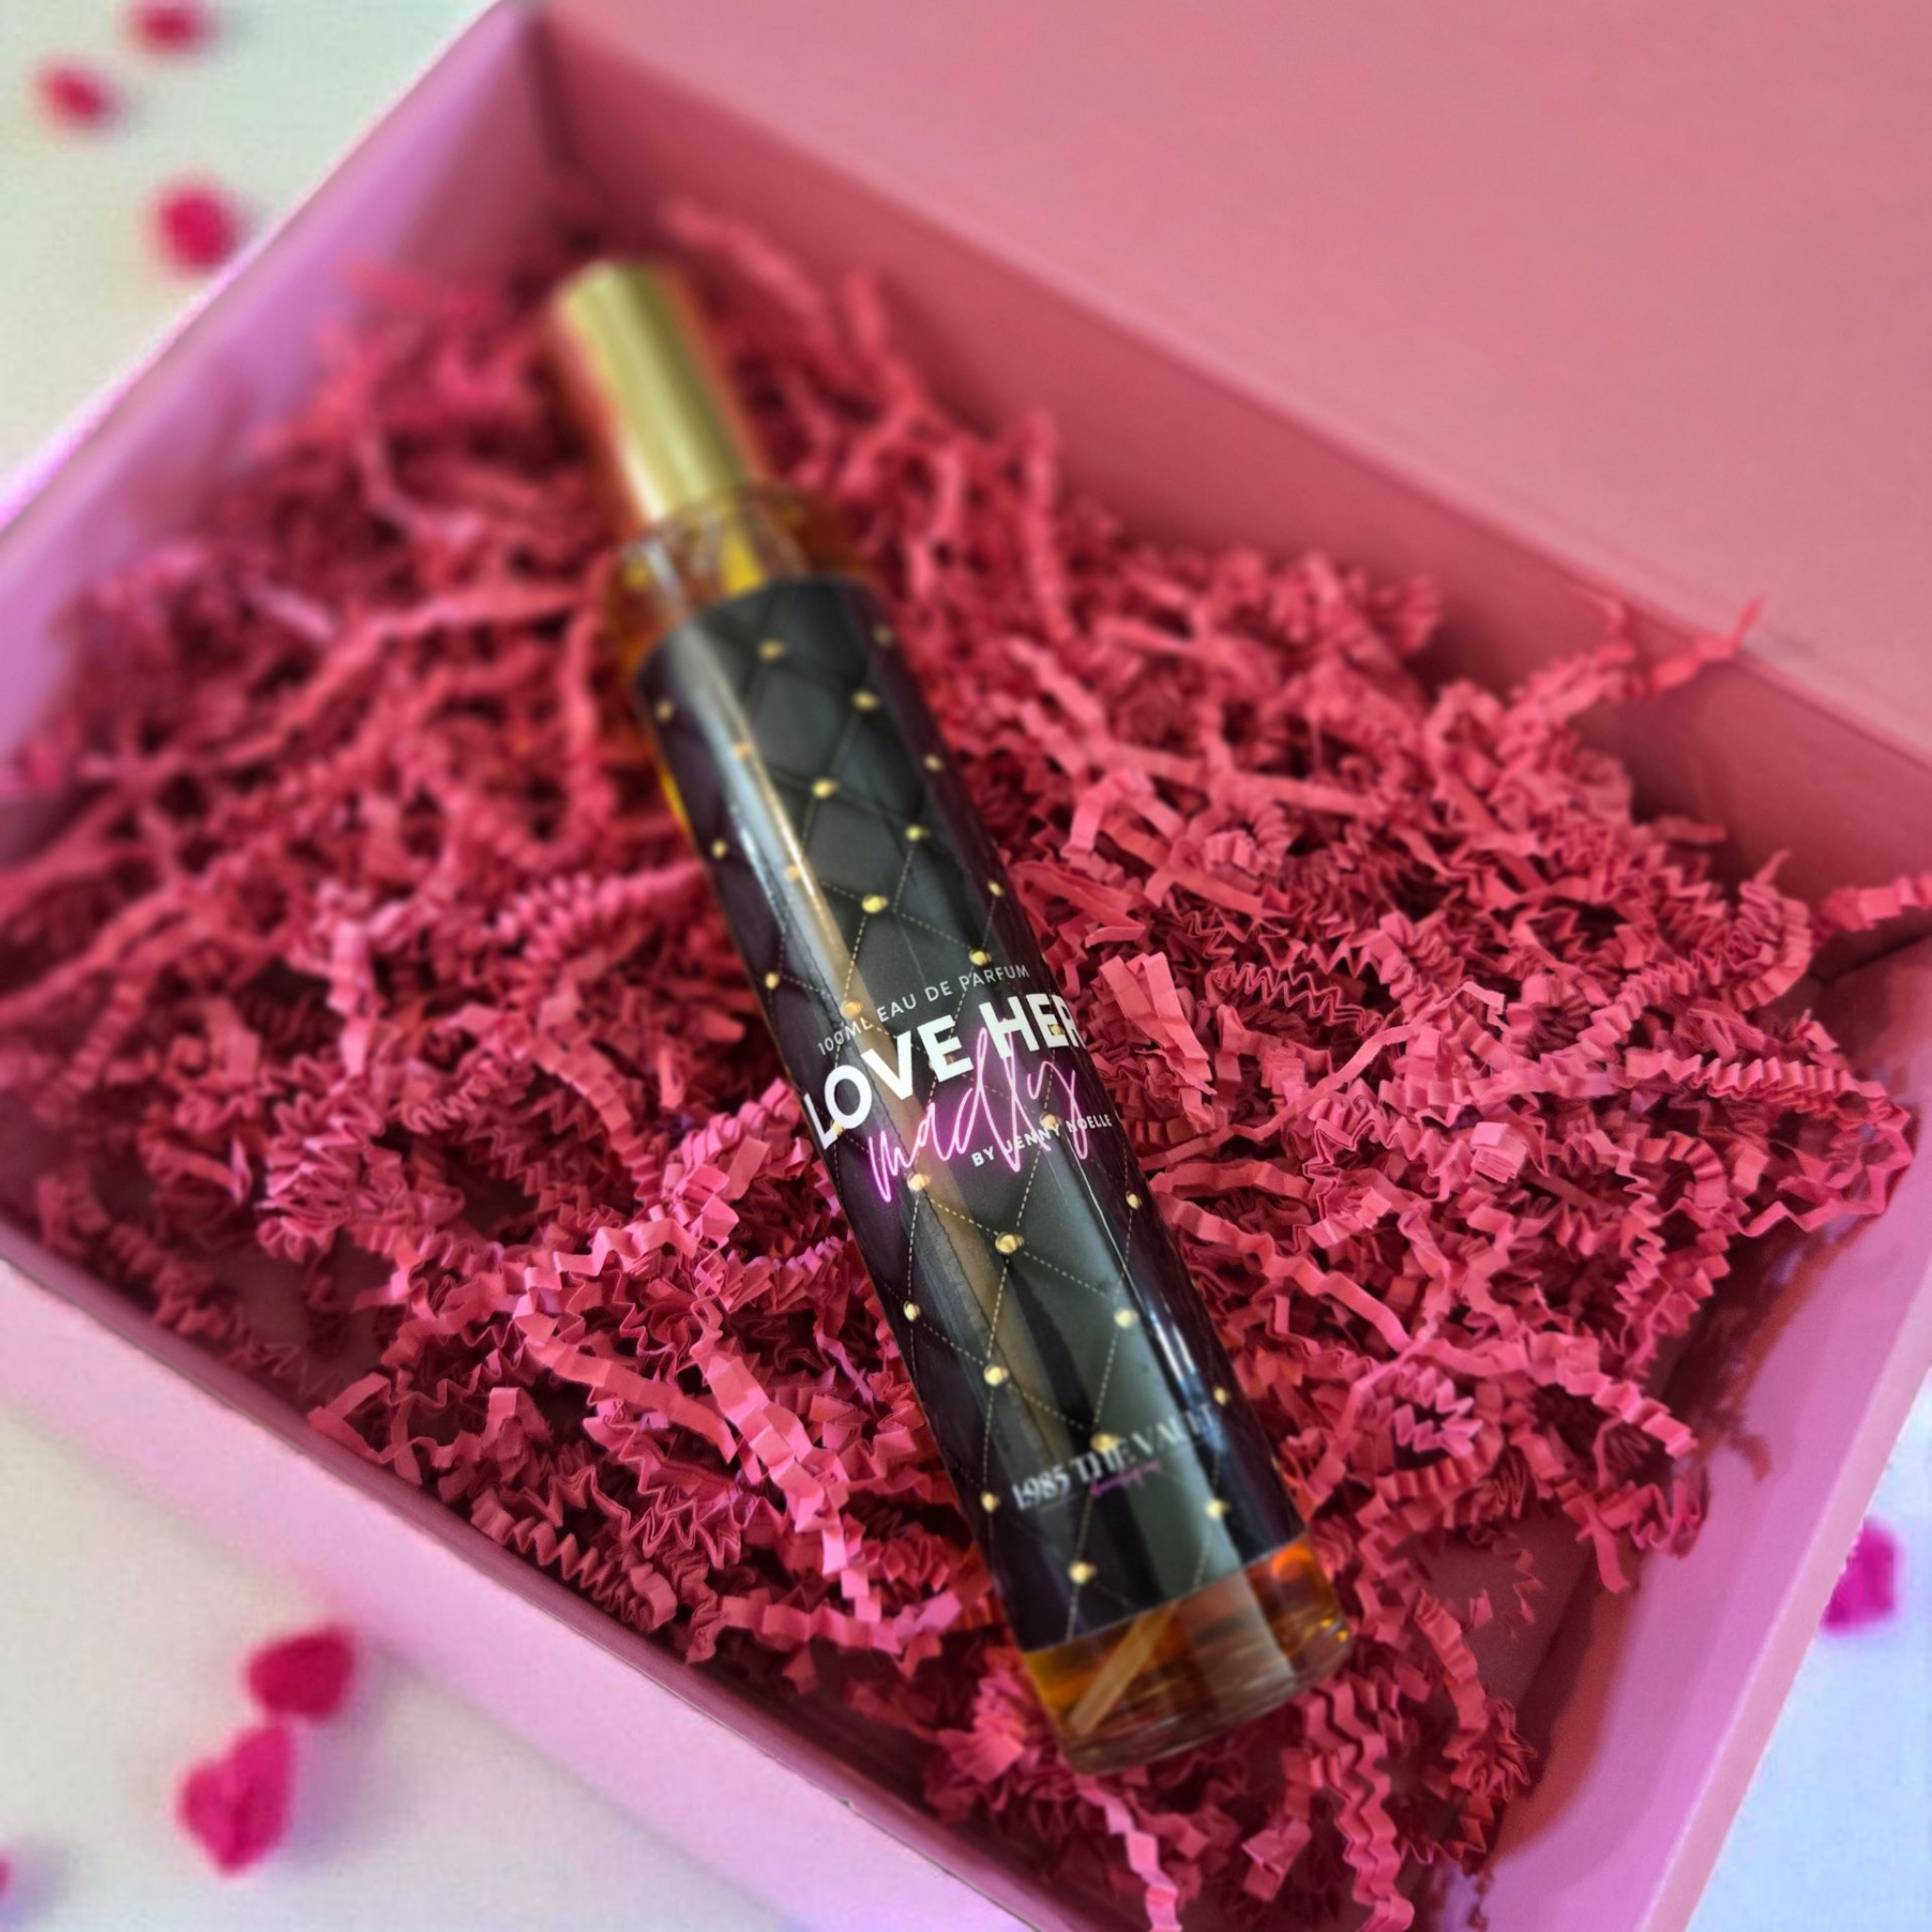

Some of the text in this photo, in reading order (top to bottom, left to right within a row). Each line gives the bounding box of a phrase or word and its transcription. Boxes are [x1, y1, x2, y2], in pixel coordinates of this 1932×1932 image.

[817, 964, 1029, 1056] 100ML EAU DE PARFUM
[804, 993, 1087, 1151] LOVE HER
[868, 1018, 1088, 1203] madly
[971, 1114, 1112, 1167] BY JENNY NOELLE
[1012, 1465, 1071, 1510] 1985
[1069, 1438, 1136, 1482] THE
